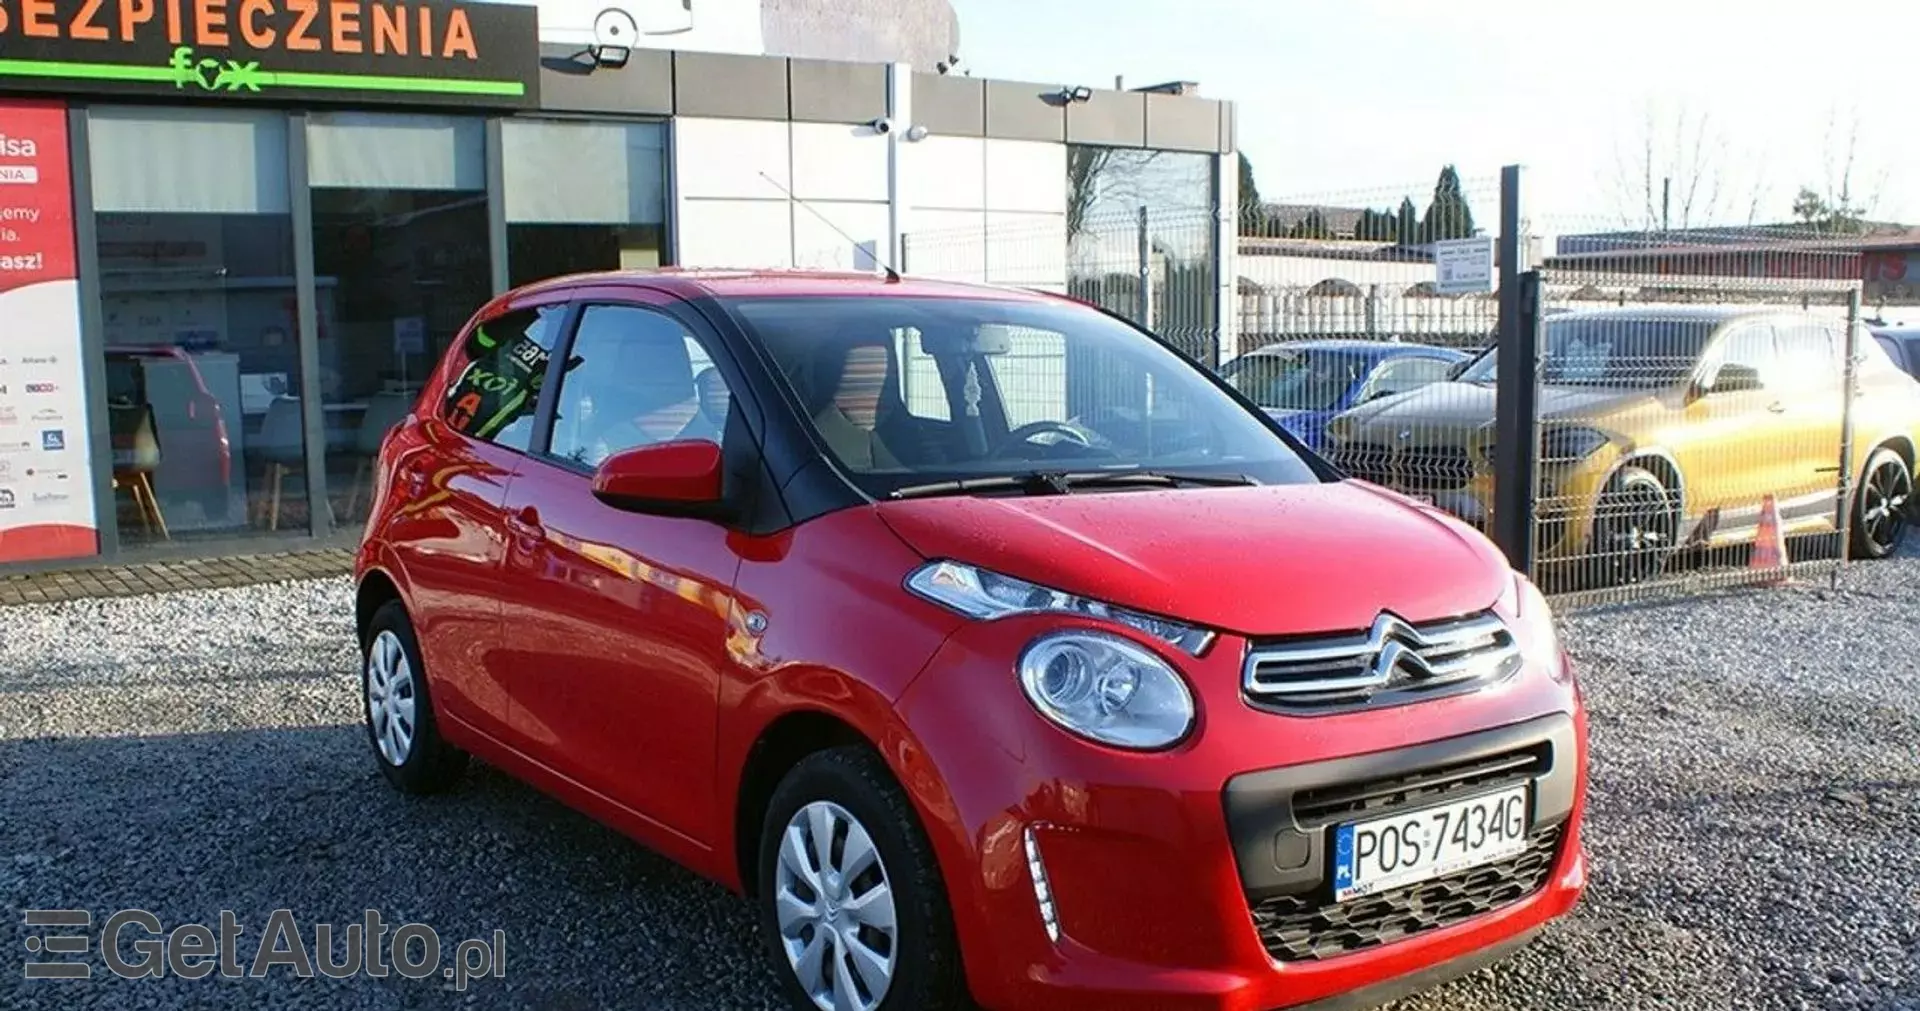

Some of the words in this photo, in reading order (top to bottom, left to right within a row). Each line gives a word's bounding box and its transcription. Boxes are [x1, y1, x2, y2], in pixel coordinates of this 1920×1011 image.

[0, 0, 479, 59] EZPIECZENIA
[169, 47, 261, 92] fox
[0, 207, 40, 223] emy
[1355, 820, 1421, 880] POS
[1432, 795, 1523, 861] 7434G
